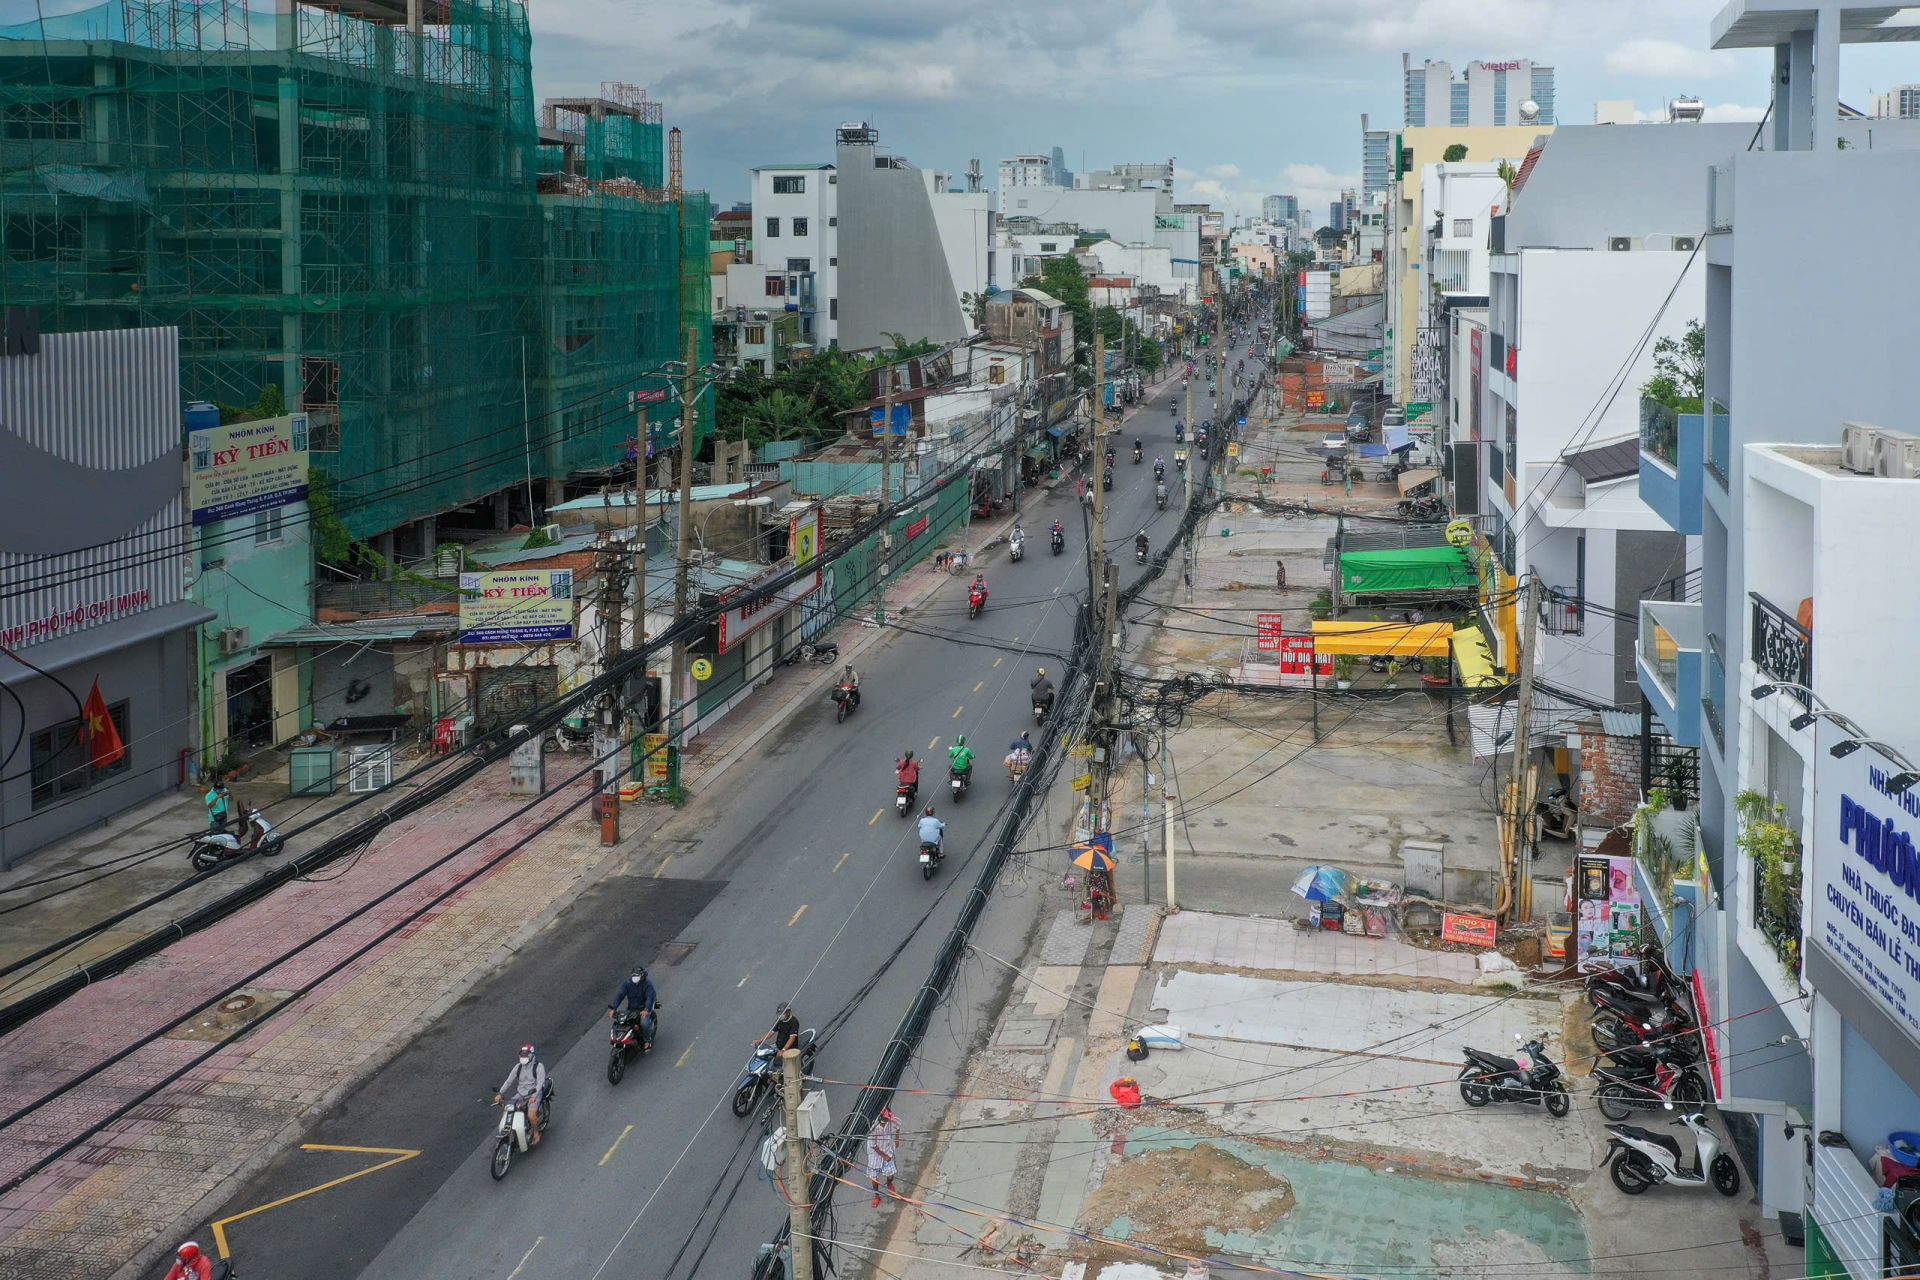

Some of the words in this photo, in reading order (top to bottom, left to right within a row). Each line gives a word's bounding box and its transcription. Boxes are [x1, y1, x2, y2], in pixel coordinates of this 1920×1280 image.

[1480, 62, 1521, 71] viettel
[1417, 331, 1440, 347] GYM
[1417, 355, 1441, 372] YOGA
[229, 425, 254, 440] NHÔM
[256, 424, 275, 437] KÍNH
[213, 445, 241, 467] KỲ
[247, 434, 290, 460] TIẾN
[492, 575, 517, 583] NHÔM
[519, 574, 540, 582] KÍNH
[483, 585, 505, 598] KỲ
[510, 583, 548, 598] TIẾN
[0, 626, 24, 646] NH
[28, 606, 60, 640] PHỐ
[65, 600, 85, 627] HỒ
[89, 593, 114, 619] CHÍ
[117, 588, 150, 612] MINH
[1842, 862, 1863, 896] NHÀ
[1864, 880, 1899, 926] THUỐC
[1826, 882, 1864, 931] CHUYÊN
[1865, 917, 1887, 952] BÁN
[1889, 937, 1902, 966] LẺ
